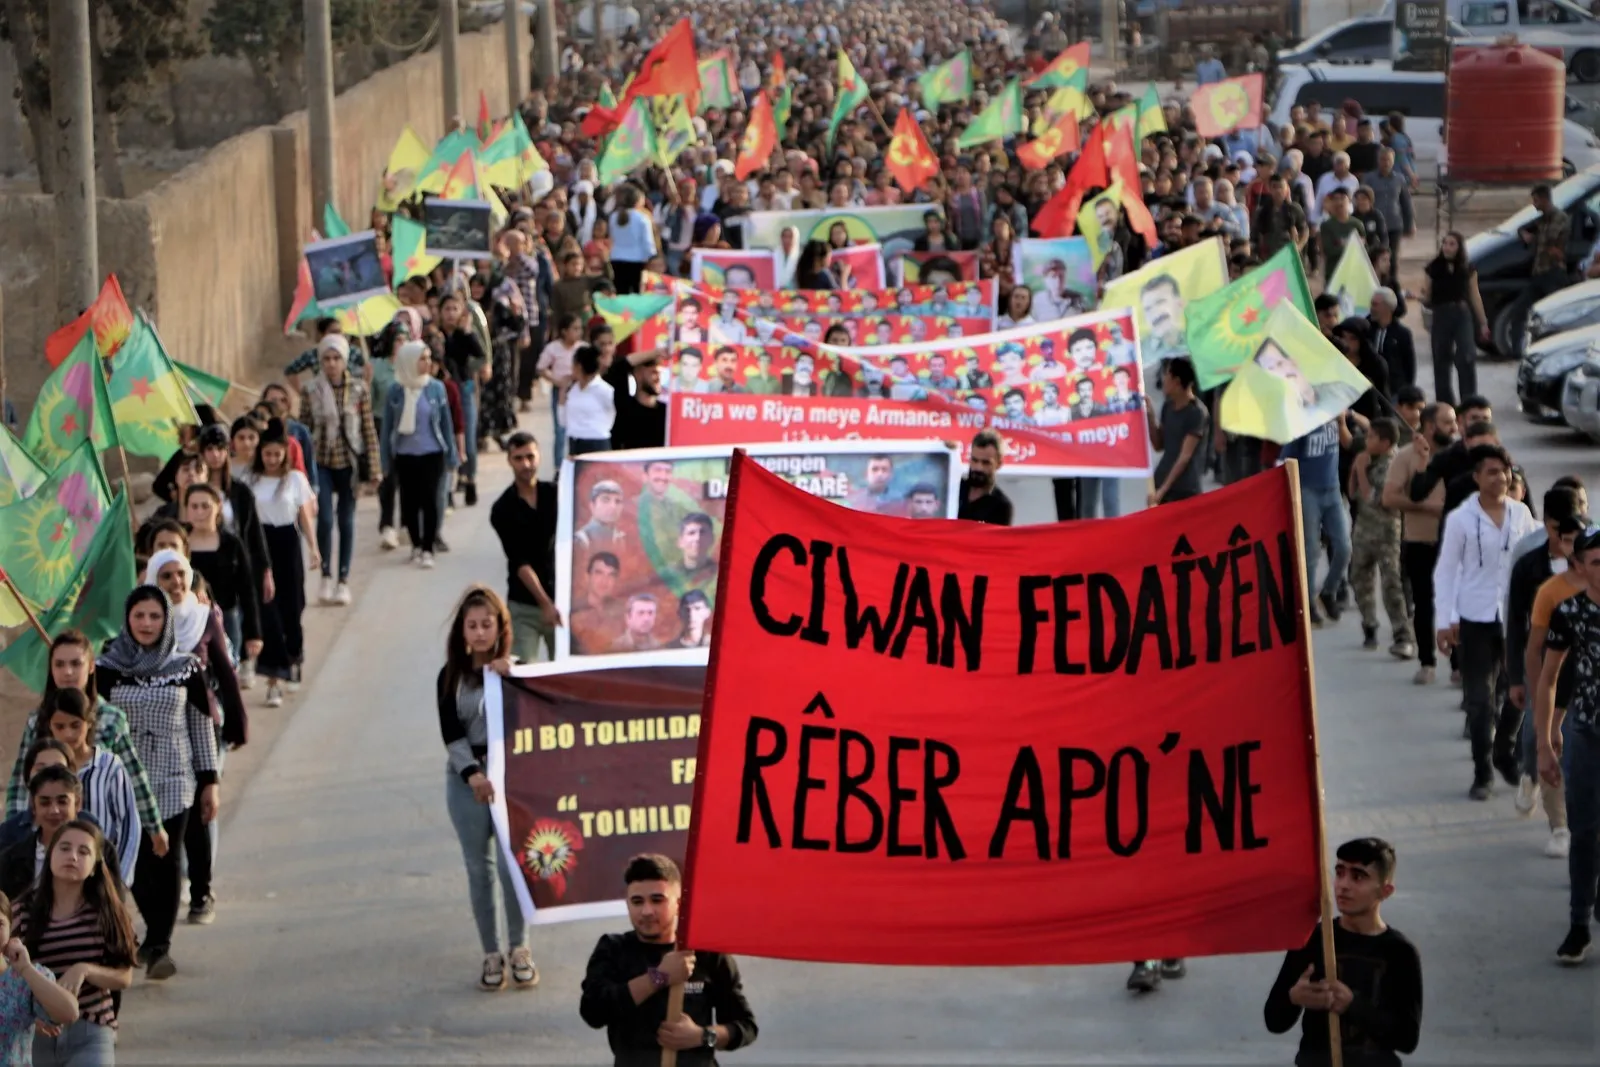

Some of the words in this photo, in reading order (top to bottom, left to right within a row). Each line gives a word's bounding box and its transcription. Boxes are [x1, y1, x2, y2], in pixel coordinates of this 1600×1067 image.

[681, 398, 724, 424] Riya
[728, 403, 757, 420] we
[762, 399, 804, 427] Riya
[809, 407, 861, 429] meye
[866, 404, 952, 427] Armanca
[957, 411, 986, 427] we
[1078, 422, 1130, 447] meye
[750, 533, 988, 672] CIWAN
[1017, 523, 1297, 675] FEDAÎYÊN
[512, 728, 534, 755] JI
[539, 723, 575, 751] BO
[736, 691, 967, 862] RÊBER
